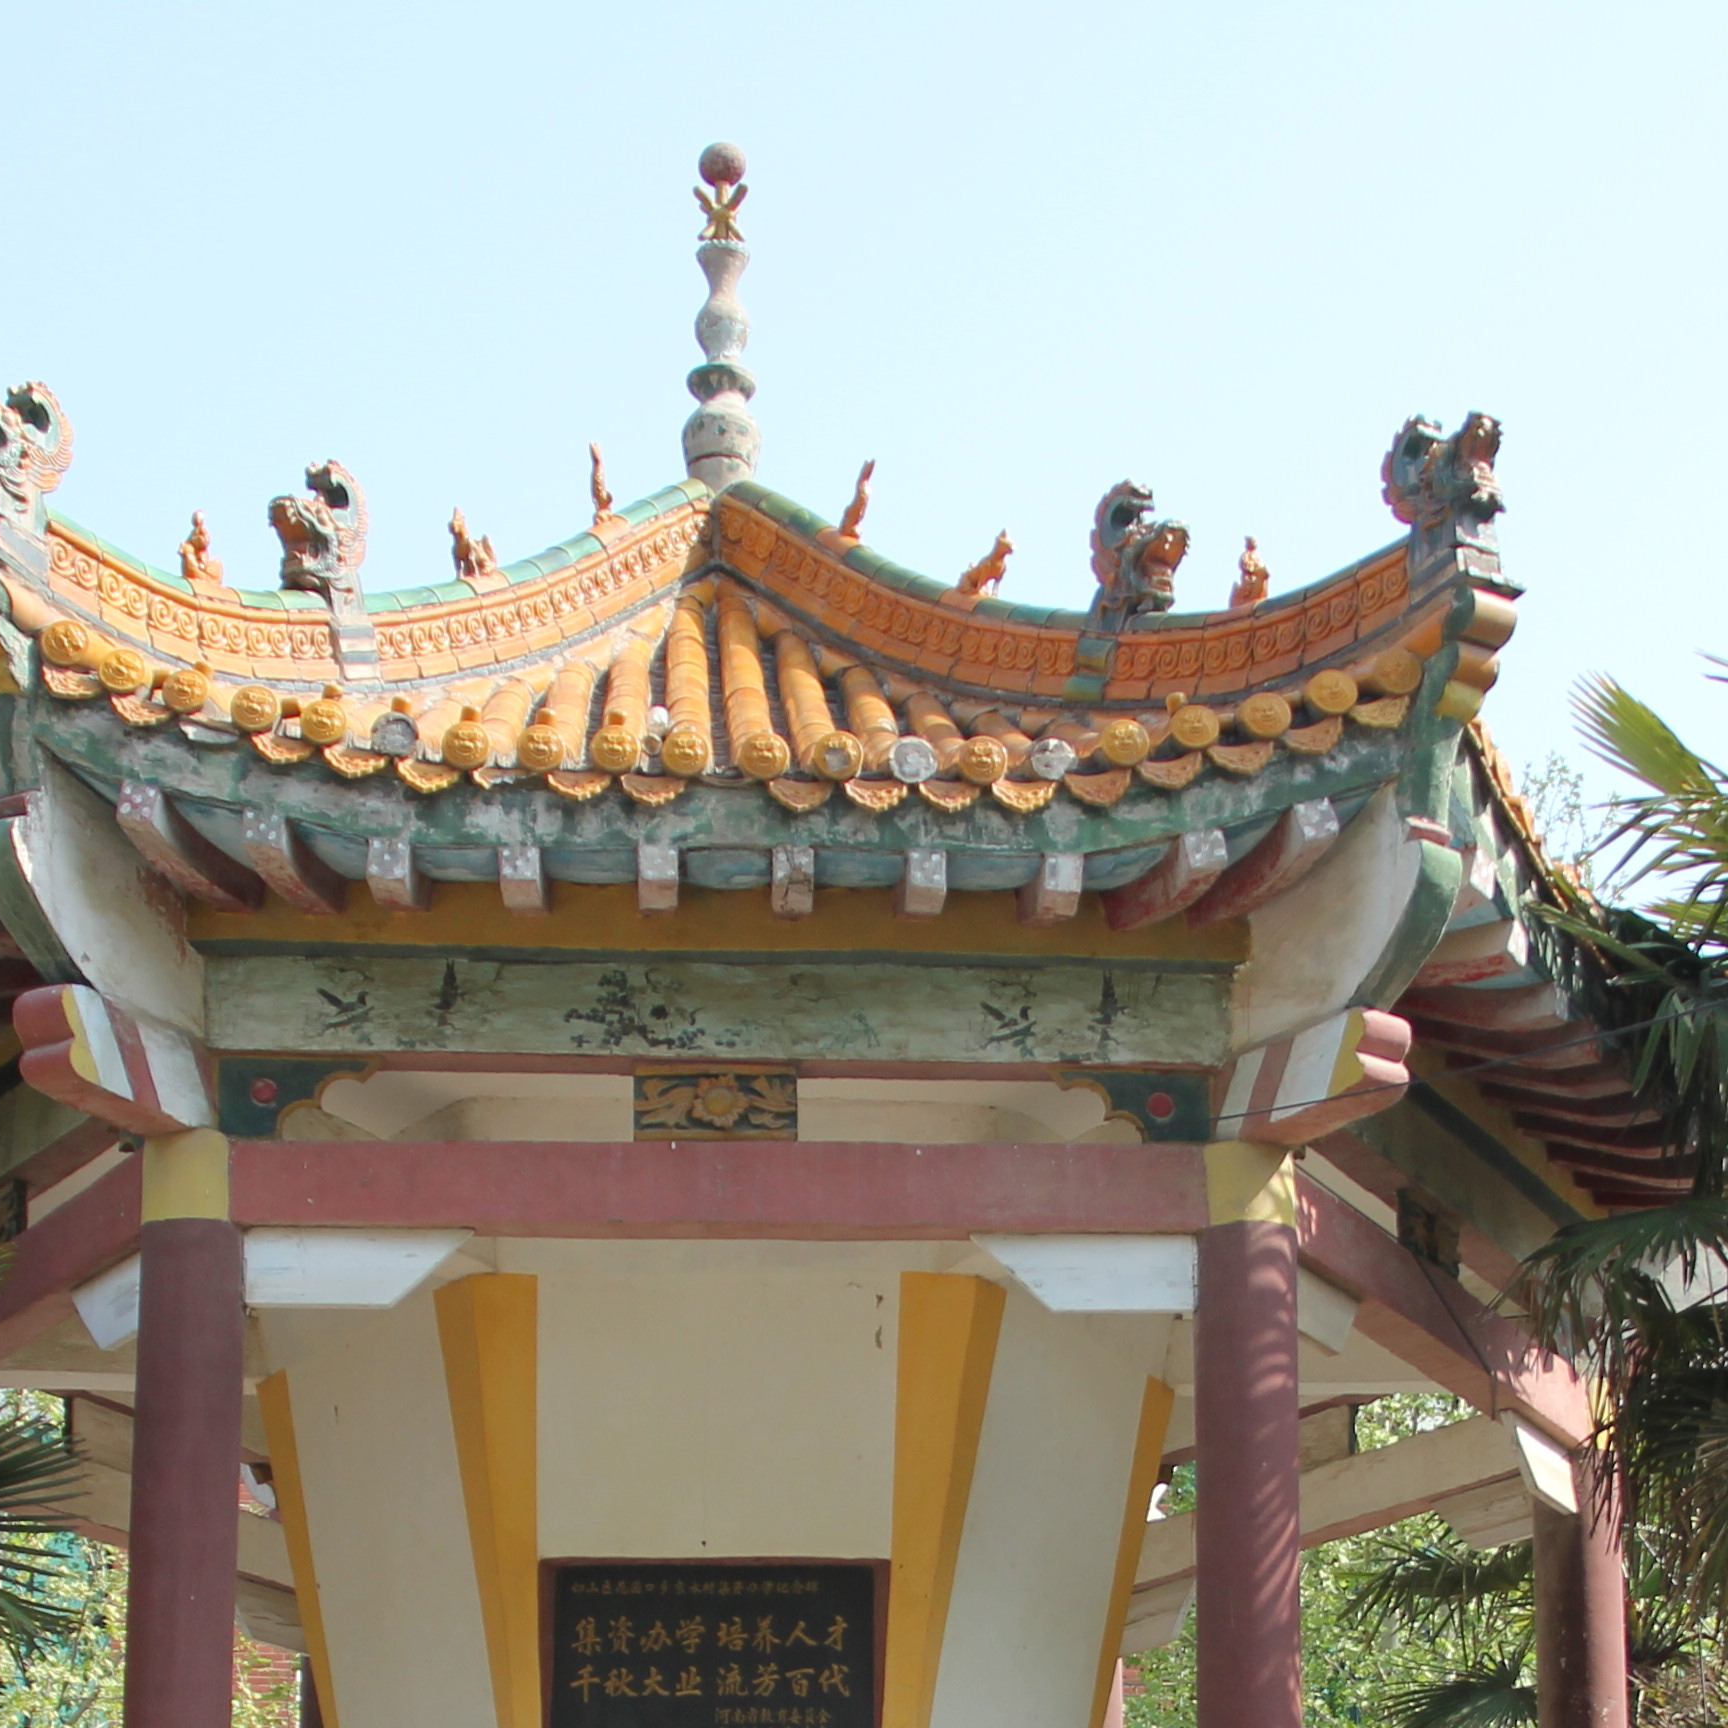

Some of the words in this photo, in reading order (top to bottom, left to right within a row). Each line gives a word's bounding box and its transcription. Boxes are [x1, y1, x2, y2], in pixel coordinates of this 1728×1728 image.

[570, 1614, 706, 1655] 集资办学
[717, 1614, 850, 1655] 培养人才
[568, 1662, 704, 1703] 千秋大业
[715, 1663, 851, 1700] 流芳百代
[714, 1706, 832, 1725] 河南省教育委员会
